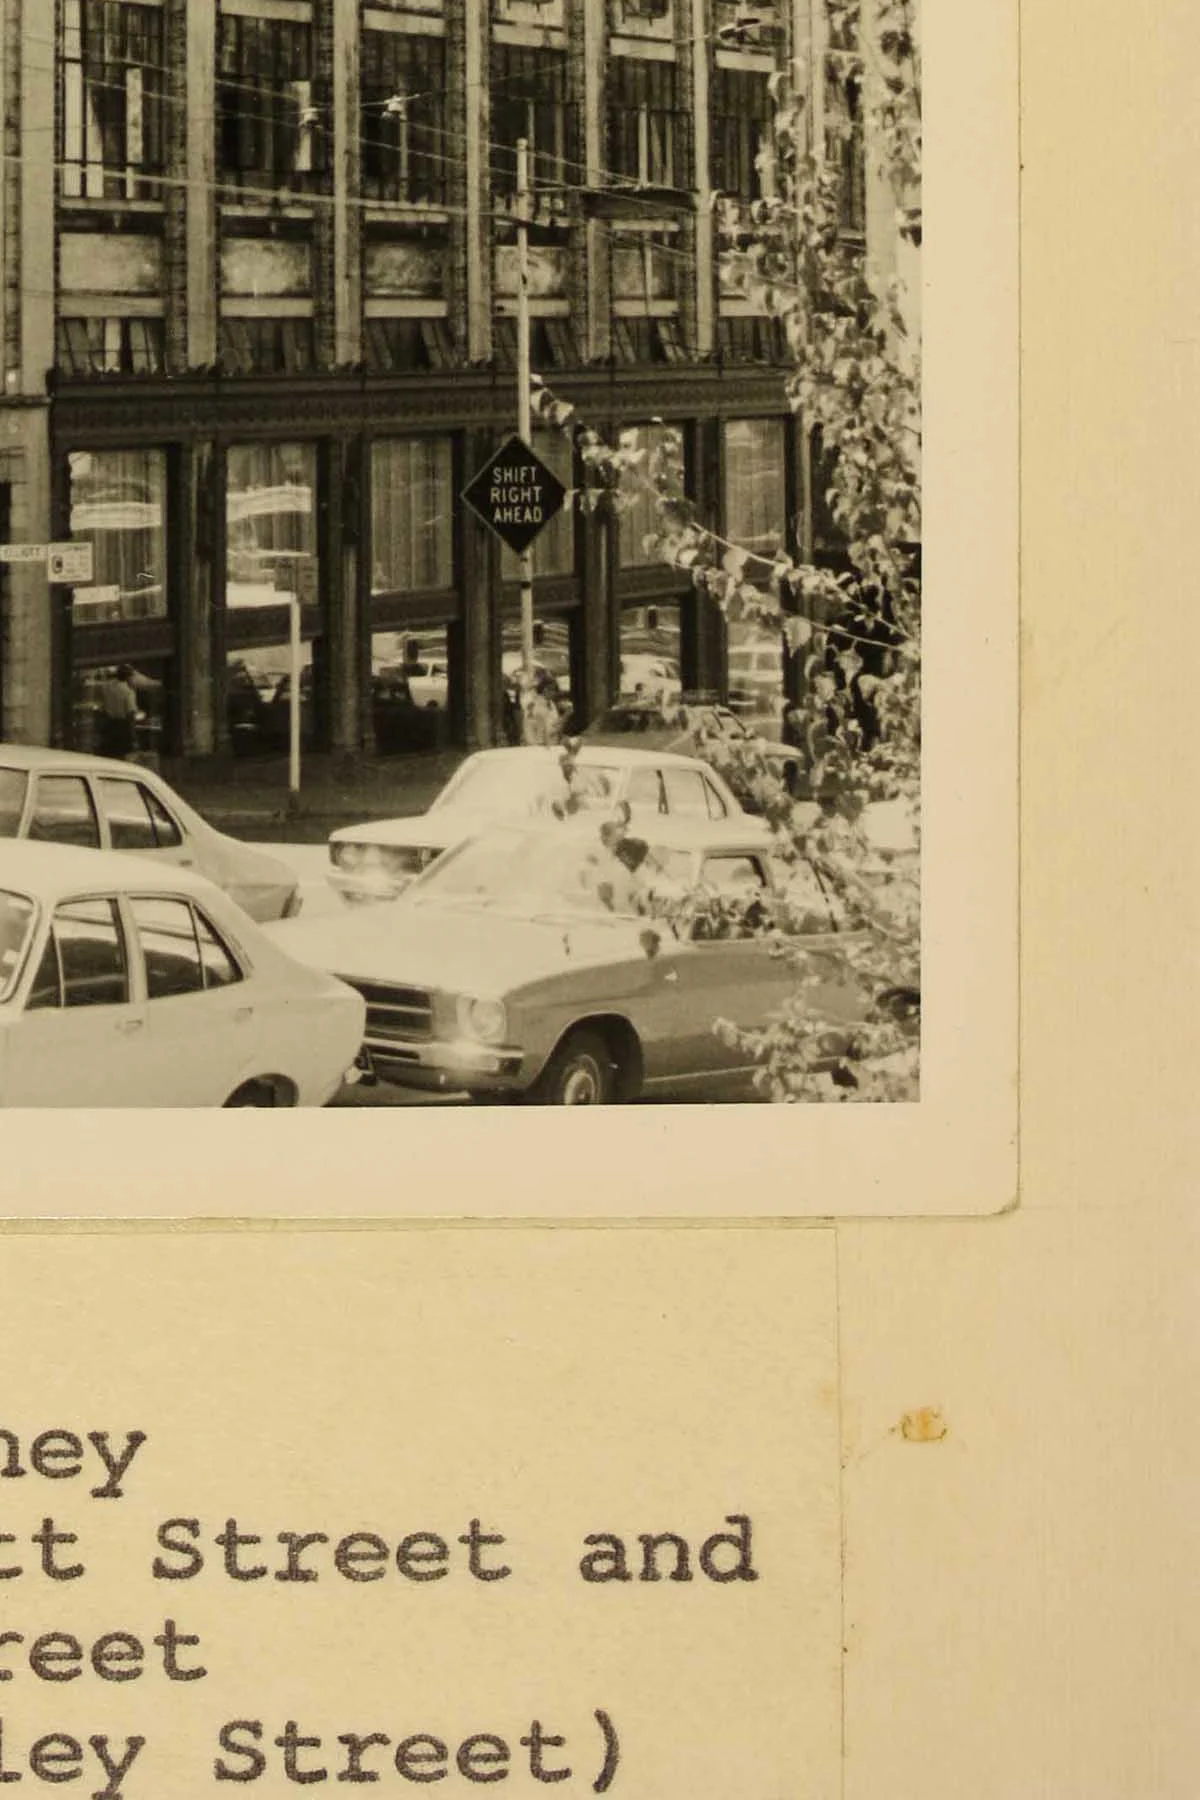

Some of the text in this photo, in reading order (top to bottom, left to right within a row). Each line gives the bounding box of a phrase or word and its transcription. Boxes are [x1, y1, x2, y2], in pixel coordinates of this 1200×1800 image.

[492, 466, 537, 484] SHIFT
[490, 486, 543, 504] RIGHT
[492, 506, 543, 523] AHEAD
[153, 1520, 513, 1584] Street
[580, 1516, 760, 1584] and
[215, 1711, 622, 1795] Street)
